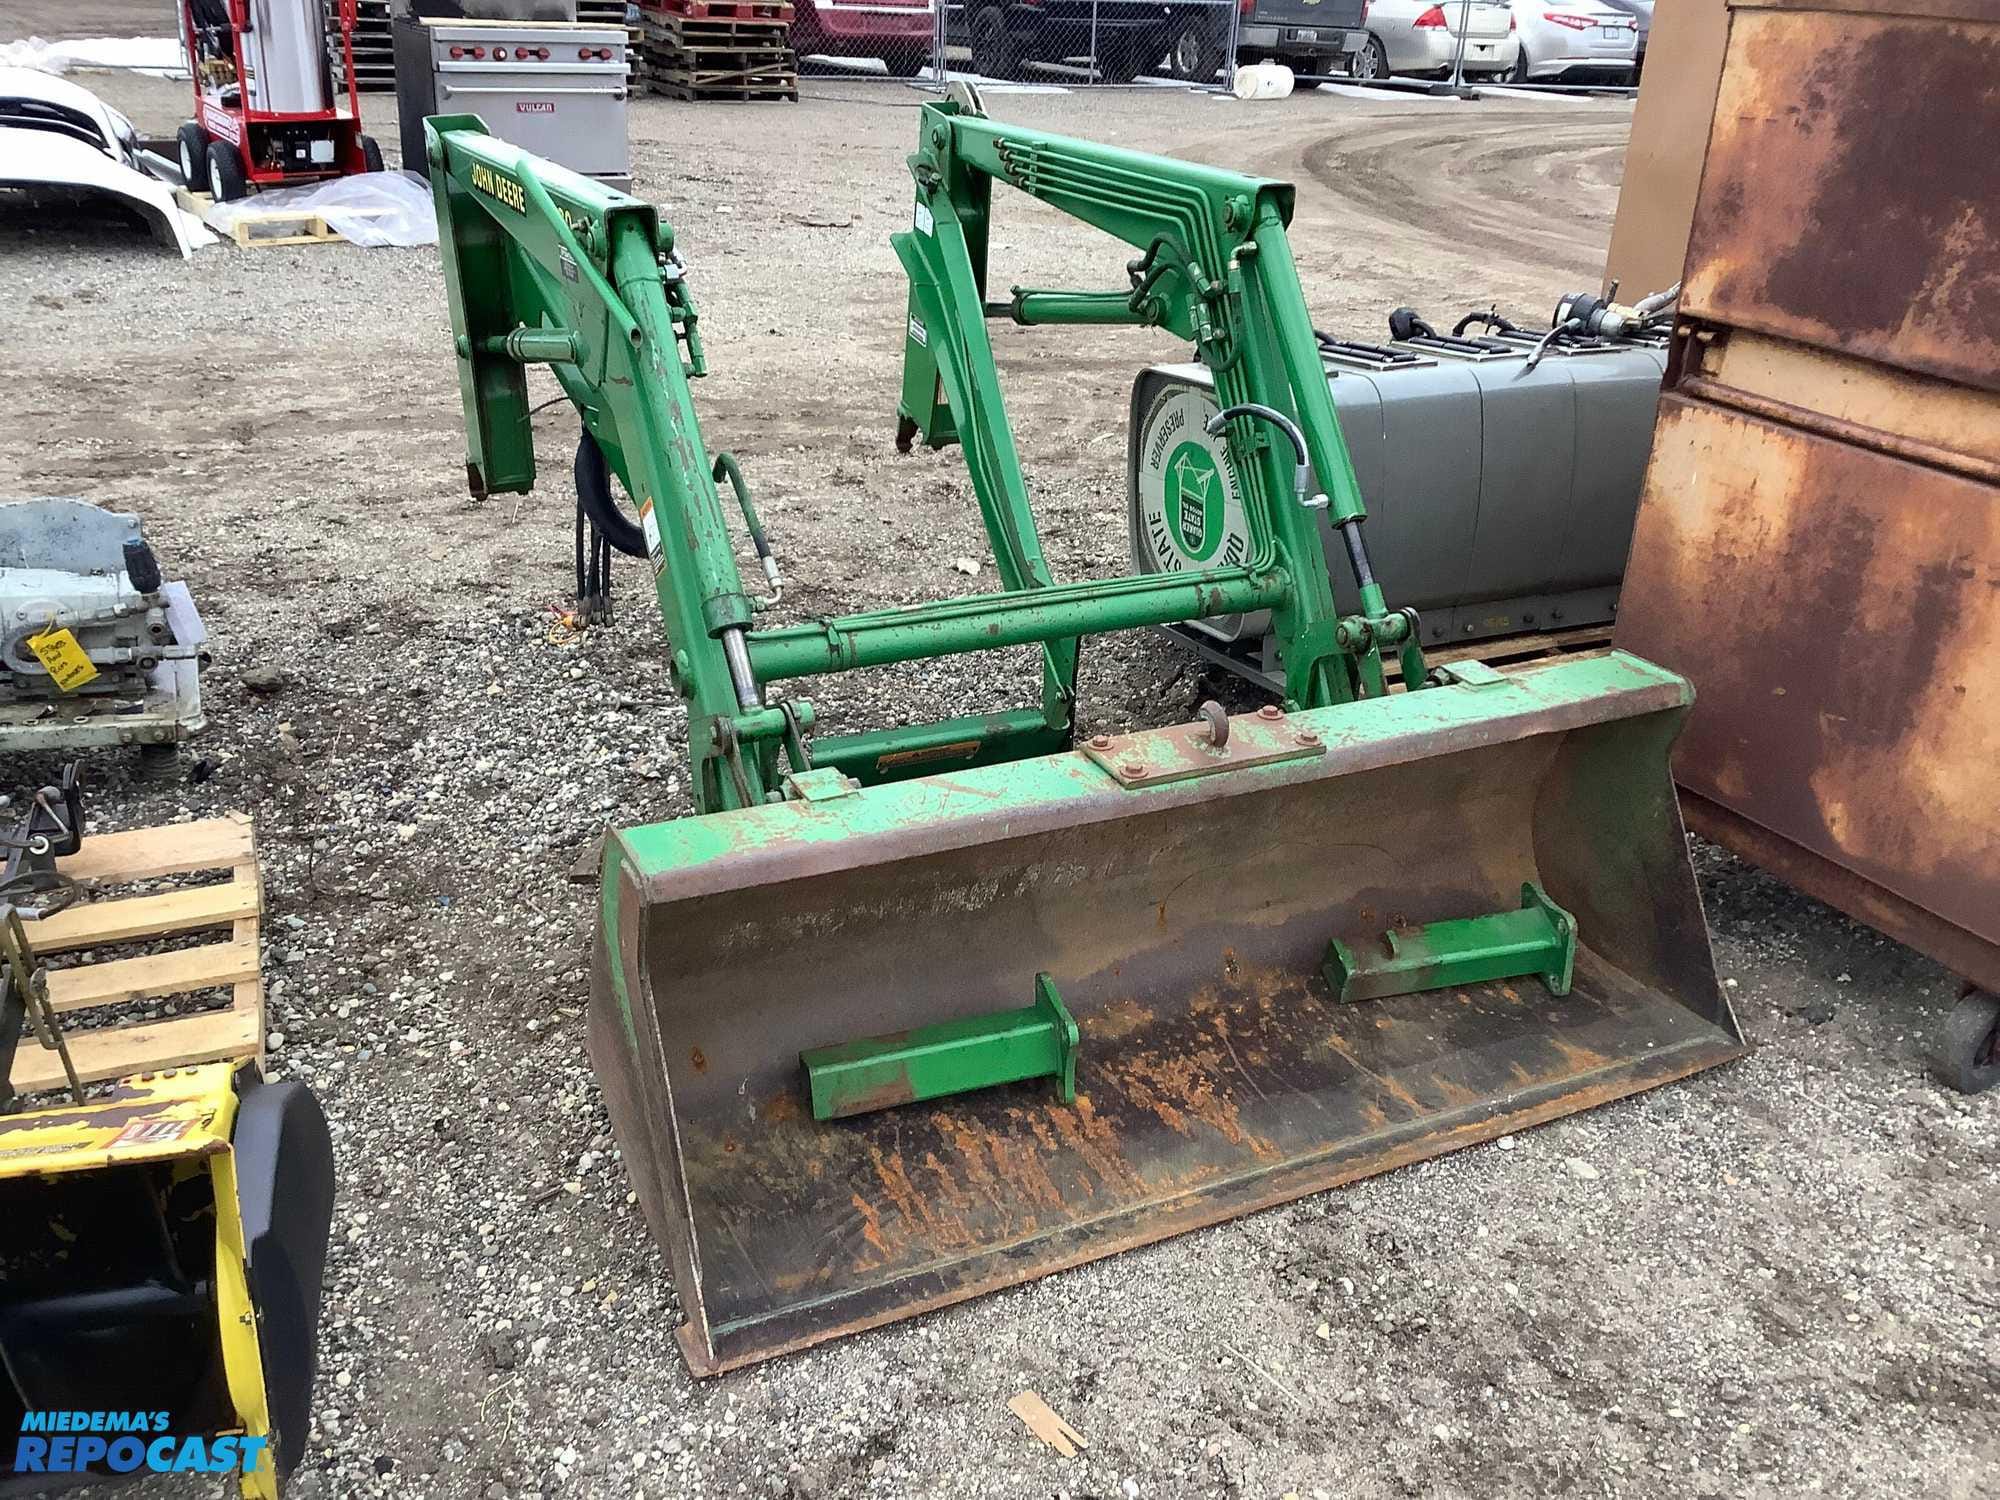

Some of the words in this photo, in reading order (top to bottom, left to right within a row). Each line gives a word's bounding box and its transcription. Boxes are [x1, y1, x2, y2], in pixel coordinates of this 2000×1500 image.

[518, 102, 553, 112] VULCAN
[471, 162, 495, 196] JOHN
[495, 172, 526, 215] DEERE
[1150, 408, 1185, 470] PRESERVER
[1182, 523, 1203, 539] QUAKER
[1183, 511, 1202, 526] STATE
[1148, 511, 1182, 572] STATE
